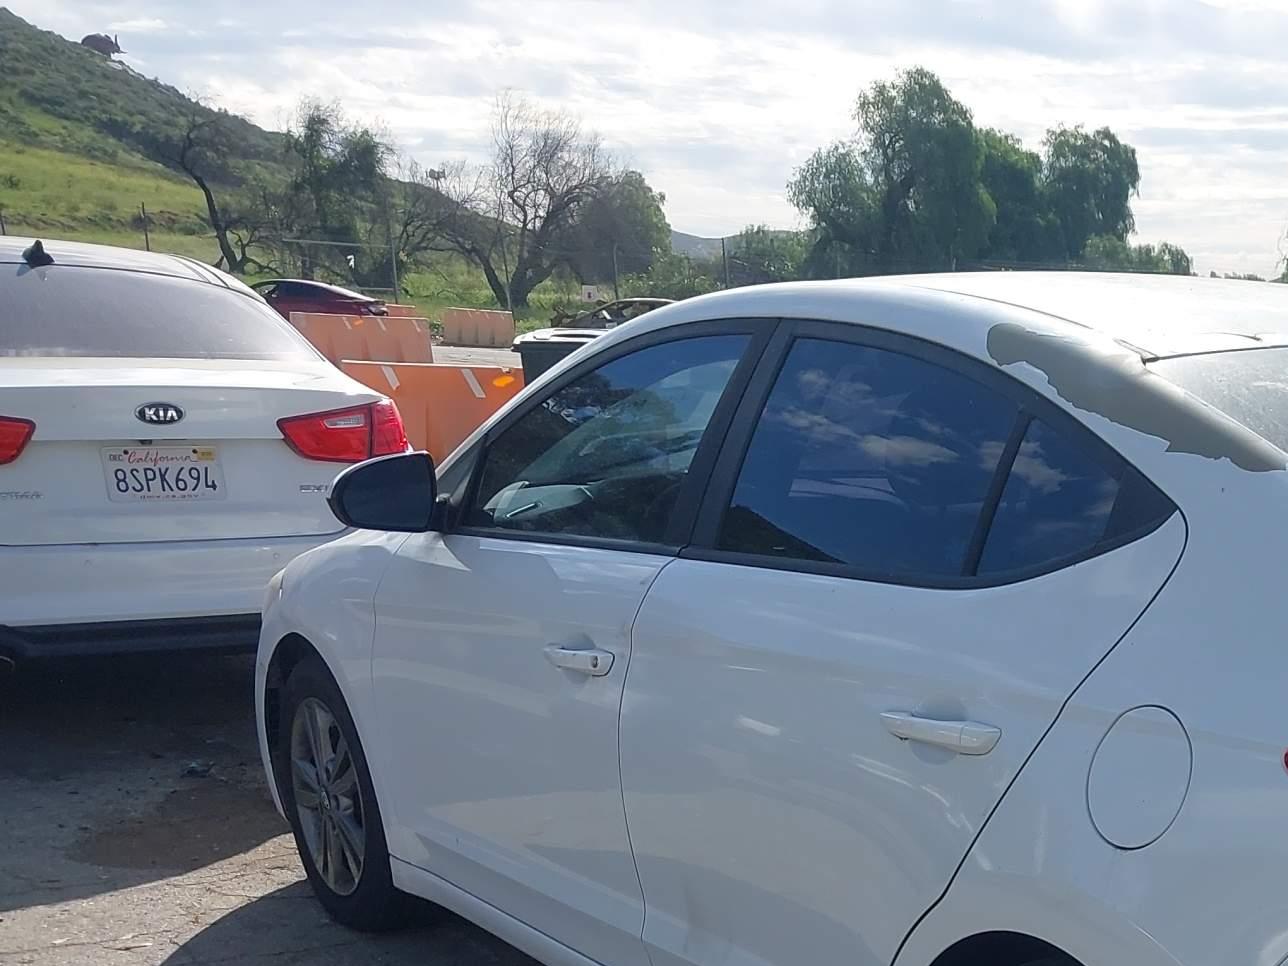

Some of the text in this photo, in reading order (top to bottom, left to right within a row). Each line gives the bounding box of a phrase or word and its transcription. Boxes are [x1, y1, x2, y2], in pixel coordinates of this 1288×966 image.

[144, 407, 179, 421] KIA
[127, 450, 200, 467] California
[114, 466, 217, 493] 8SPK694
